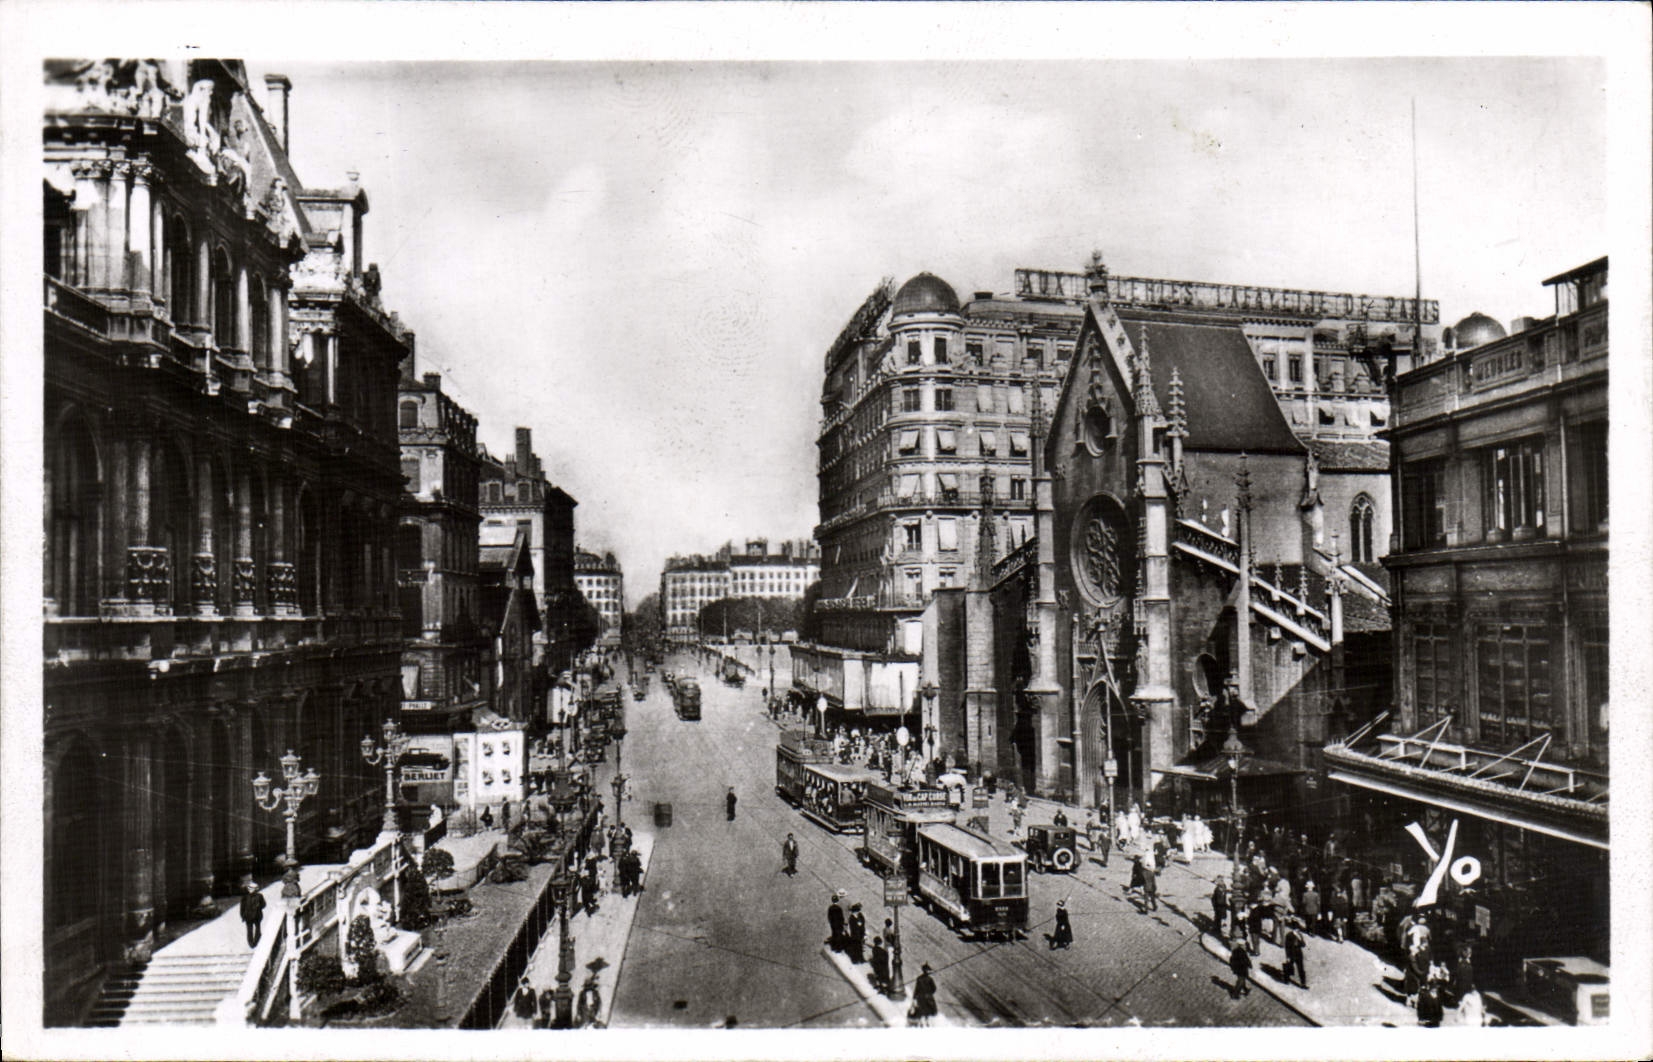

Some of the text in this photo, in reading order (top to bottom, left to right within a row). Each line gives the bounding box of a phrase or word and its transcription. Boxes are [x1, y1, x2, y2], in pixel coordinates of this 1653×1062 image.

[1021, 270, 1064, 296] AUX
[1216, 284, 1329, 313] LAFAYETTE
[1386, 297, 1439, 321] PARIS
[404, 771, 446, 781] BERLIET
